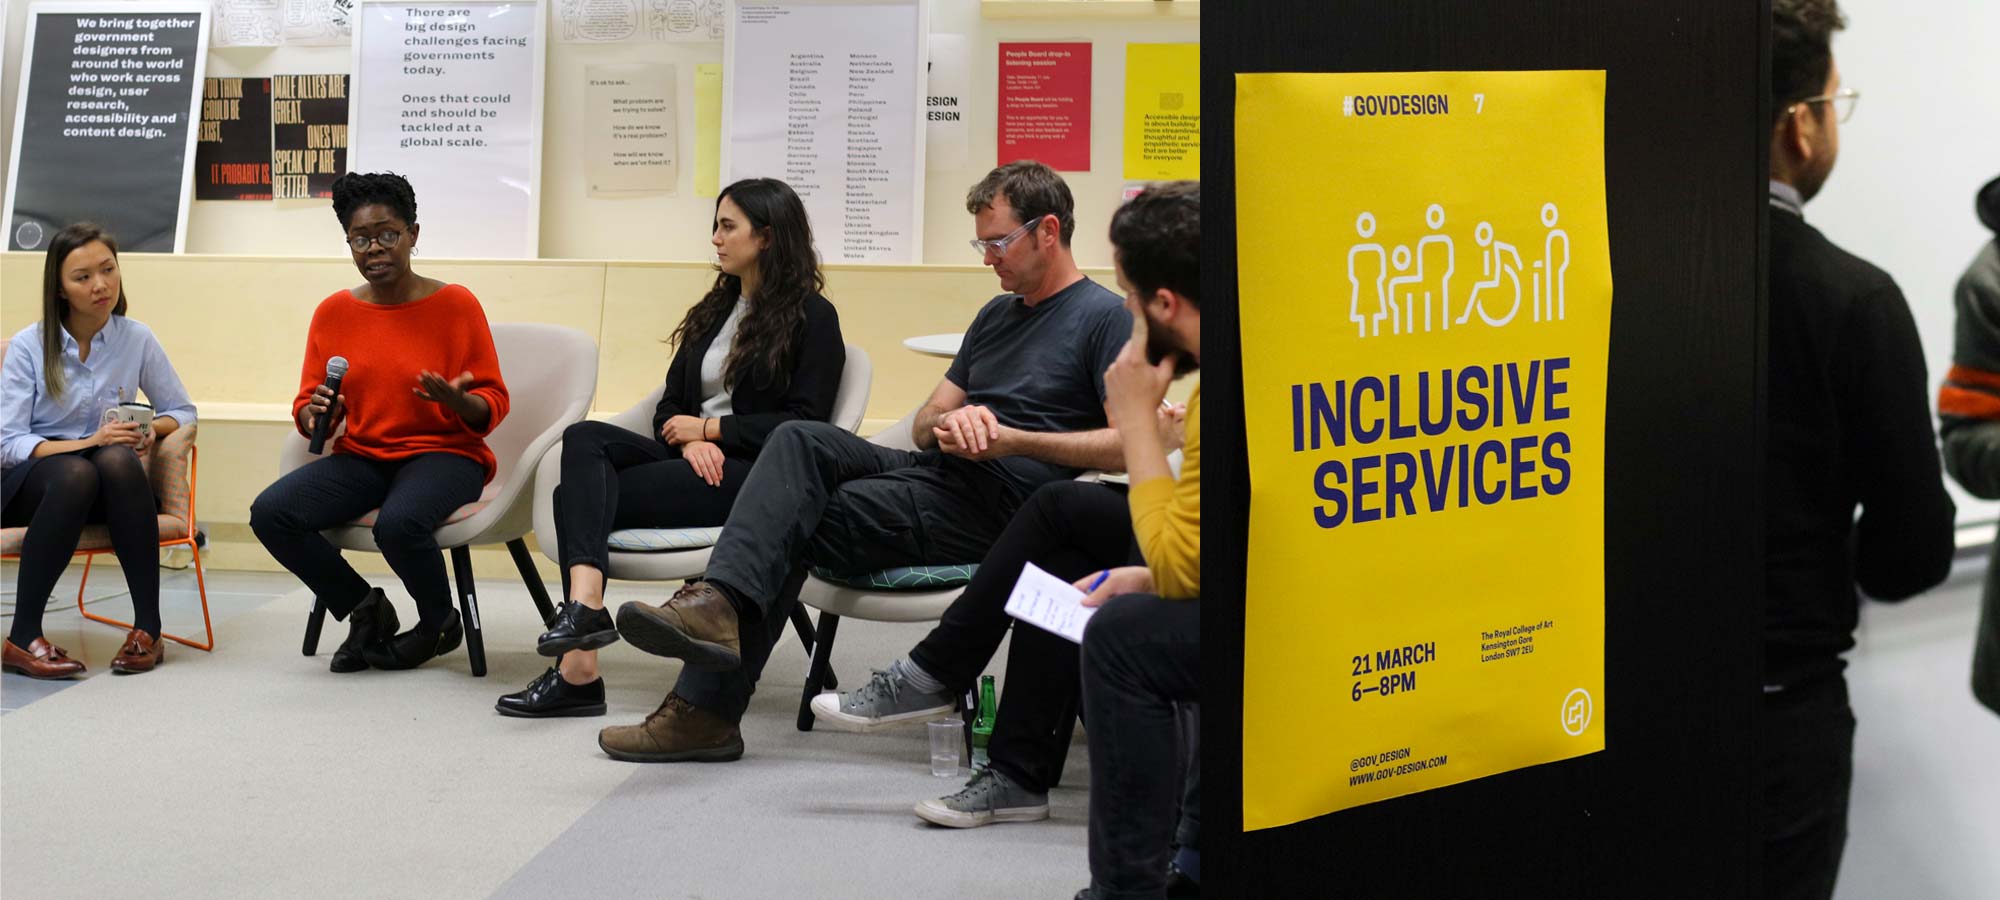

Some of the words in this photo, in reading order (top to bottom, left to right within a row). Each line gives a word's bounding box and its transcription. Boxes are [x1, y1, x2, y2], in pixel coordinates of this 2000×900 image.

[406, 8, 444, 16] There
[77, 18, 96, 28] We
[99, 18, 133, 29] bring
[137, 18, 194, 29] together
[406, 22, 426, 33] big
[430, 22, 475, 33] design
[74, 33, 154, 43] government
[405, 36, 479, 47] challenges
[483, 36, 527, 47] facing
[73, 45, 137, 56] designers
[141, 45, 172, 54] from
[1048, 50, 1071, 58] drop-in
[404, 52, 495, 62] governments
[72, 59, 118, 68] around
[121, 59, 143, 68] the
[146, 59, 183, 68] world
[404, 66, 445, 76] today.
[71, 73, 97, 82] who
[101, 73, 133, 82] work
[136, 74, 180, 82] across
[68, 86, 116, 97] design,
[220, 79, 243, 98] THINK
[275, 76, 296, 98] MALE
[298, 75, 326, 98] ALLIES
[329, 75, 345, 98] ARE
[402, 95, 436, 103] Ones
[440, 95, 468, 103] that
[473, 94, 511, 103] could
[67, 100, 129, 111] research,
[204, 99, 229, 120] COULD
[231, 99, 240, 120] BE
[1343, 94, 1449, 117] #GOVDESIGN
[1474, 94, 1485, 114] 7
[275, 100, 304, 124] GREAT.
[402, 109, 426, 117] and
[430, 109, 476, 117] should
[481, 109, 497, 117] be
[927, 112, 960, 120] ESIGN
[65, 113, 149, 125] accessibility
[152, 113, 176, 123] and
[64, 128, 115, 136] content
[118, 127, 166, 139] design.
[197, 121, 222, 143] EXIST,
[401, 123, 452, 132] tackled
[457, 124, 470, 132] at
[307, 125, 330, 148] ONES
[400, 138, 443, 148] global
[447, 138, 487, 147] scale.
[276, 150, 303, 173] SPEAK
[305, 150, 317, 173] UP
[319, 150, 336, 173] ARE
[212, 164, 218, 184] IT
[222, 164, 259, 184] PROBABLY
[262, 164, 272, 184] IS.
[276, 175, 310, 198] BETTER.
[1292, 357, 1570, 452] INCLUSIVE
[1314, 432, 1571, 529] SERVICES
[1481, 631, 1493, 640] The
[1494, 628, 1511, 639] Royal
[1513, 623, 1535, 637] College
[1536, 621, 1542, 630] of
[1544, 620, 1553, 629] Art
[1481, 638, 1517, 652] Kensington
[1518, 635, 1533, 645] Gore
[1352, 654, 1372, 676] 21
[1376, 642, 1435, 672] MARCH
[1481, 651, 1504, 662] London
[1506, 647, 1520, 658] SW7
[1522, 645, 1534, 655] 2EU
[1351, 748, 1410, 772] @GOV_DESIGN
[1349, 755, 1447, 786] WWW.GOV-DESIGN.COM
